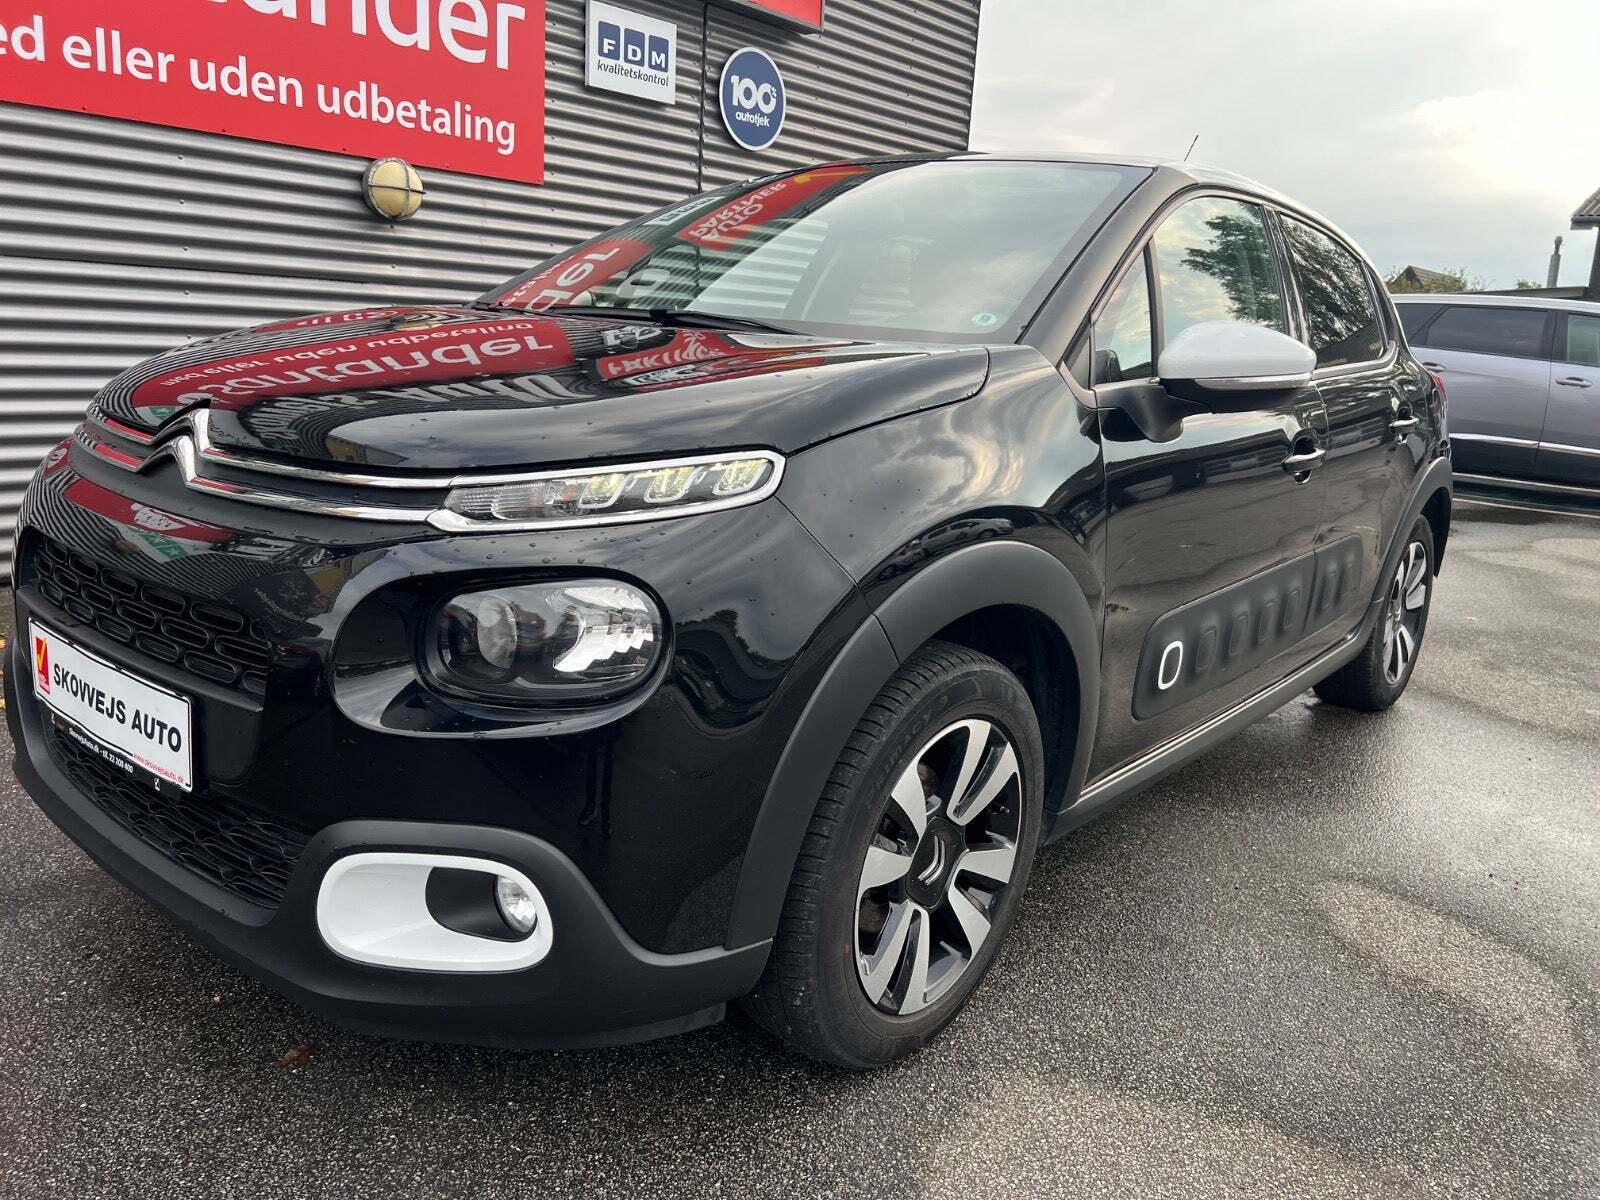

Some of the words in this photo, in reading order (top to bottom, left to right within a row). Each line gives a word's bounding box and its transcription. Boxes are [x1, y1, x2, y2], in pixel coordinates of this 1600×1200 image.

[0, 14, 46, 62] d
[62, 26, 175, 84] eller
[189, 54, 304, 108] uden
[316, 79, 516, 156] udbetaling
[597, 60, 669, 87] kvalitetskontrol
[735, 110, 770, 128] autotjek
[53, 663, 127, 725] SKOVVEJS
[131, 709, 182, 753] AUTO
